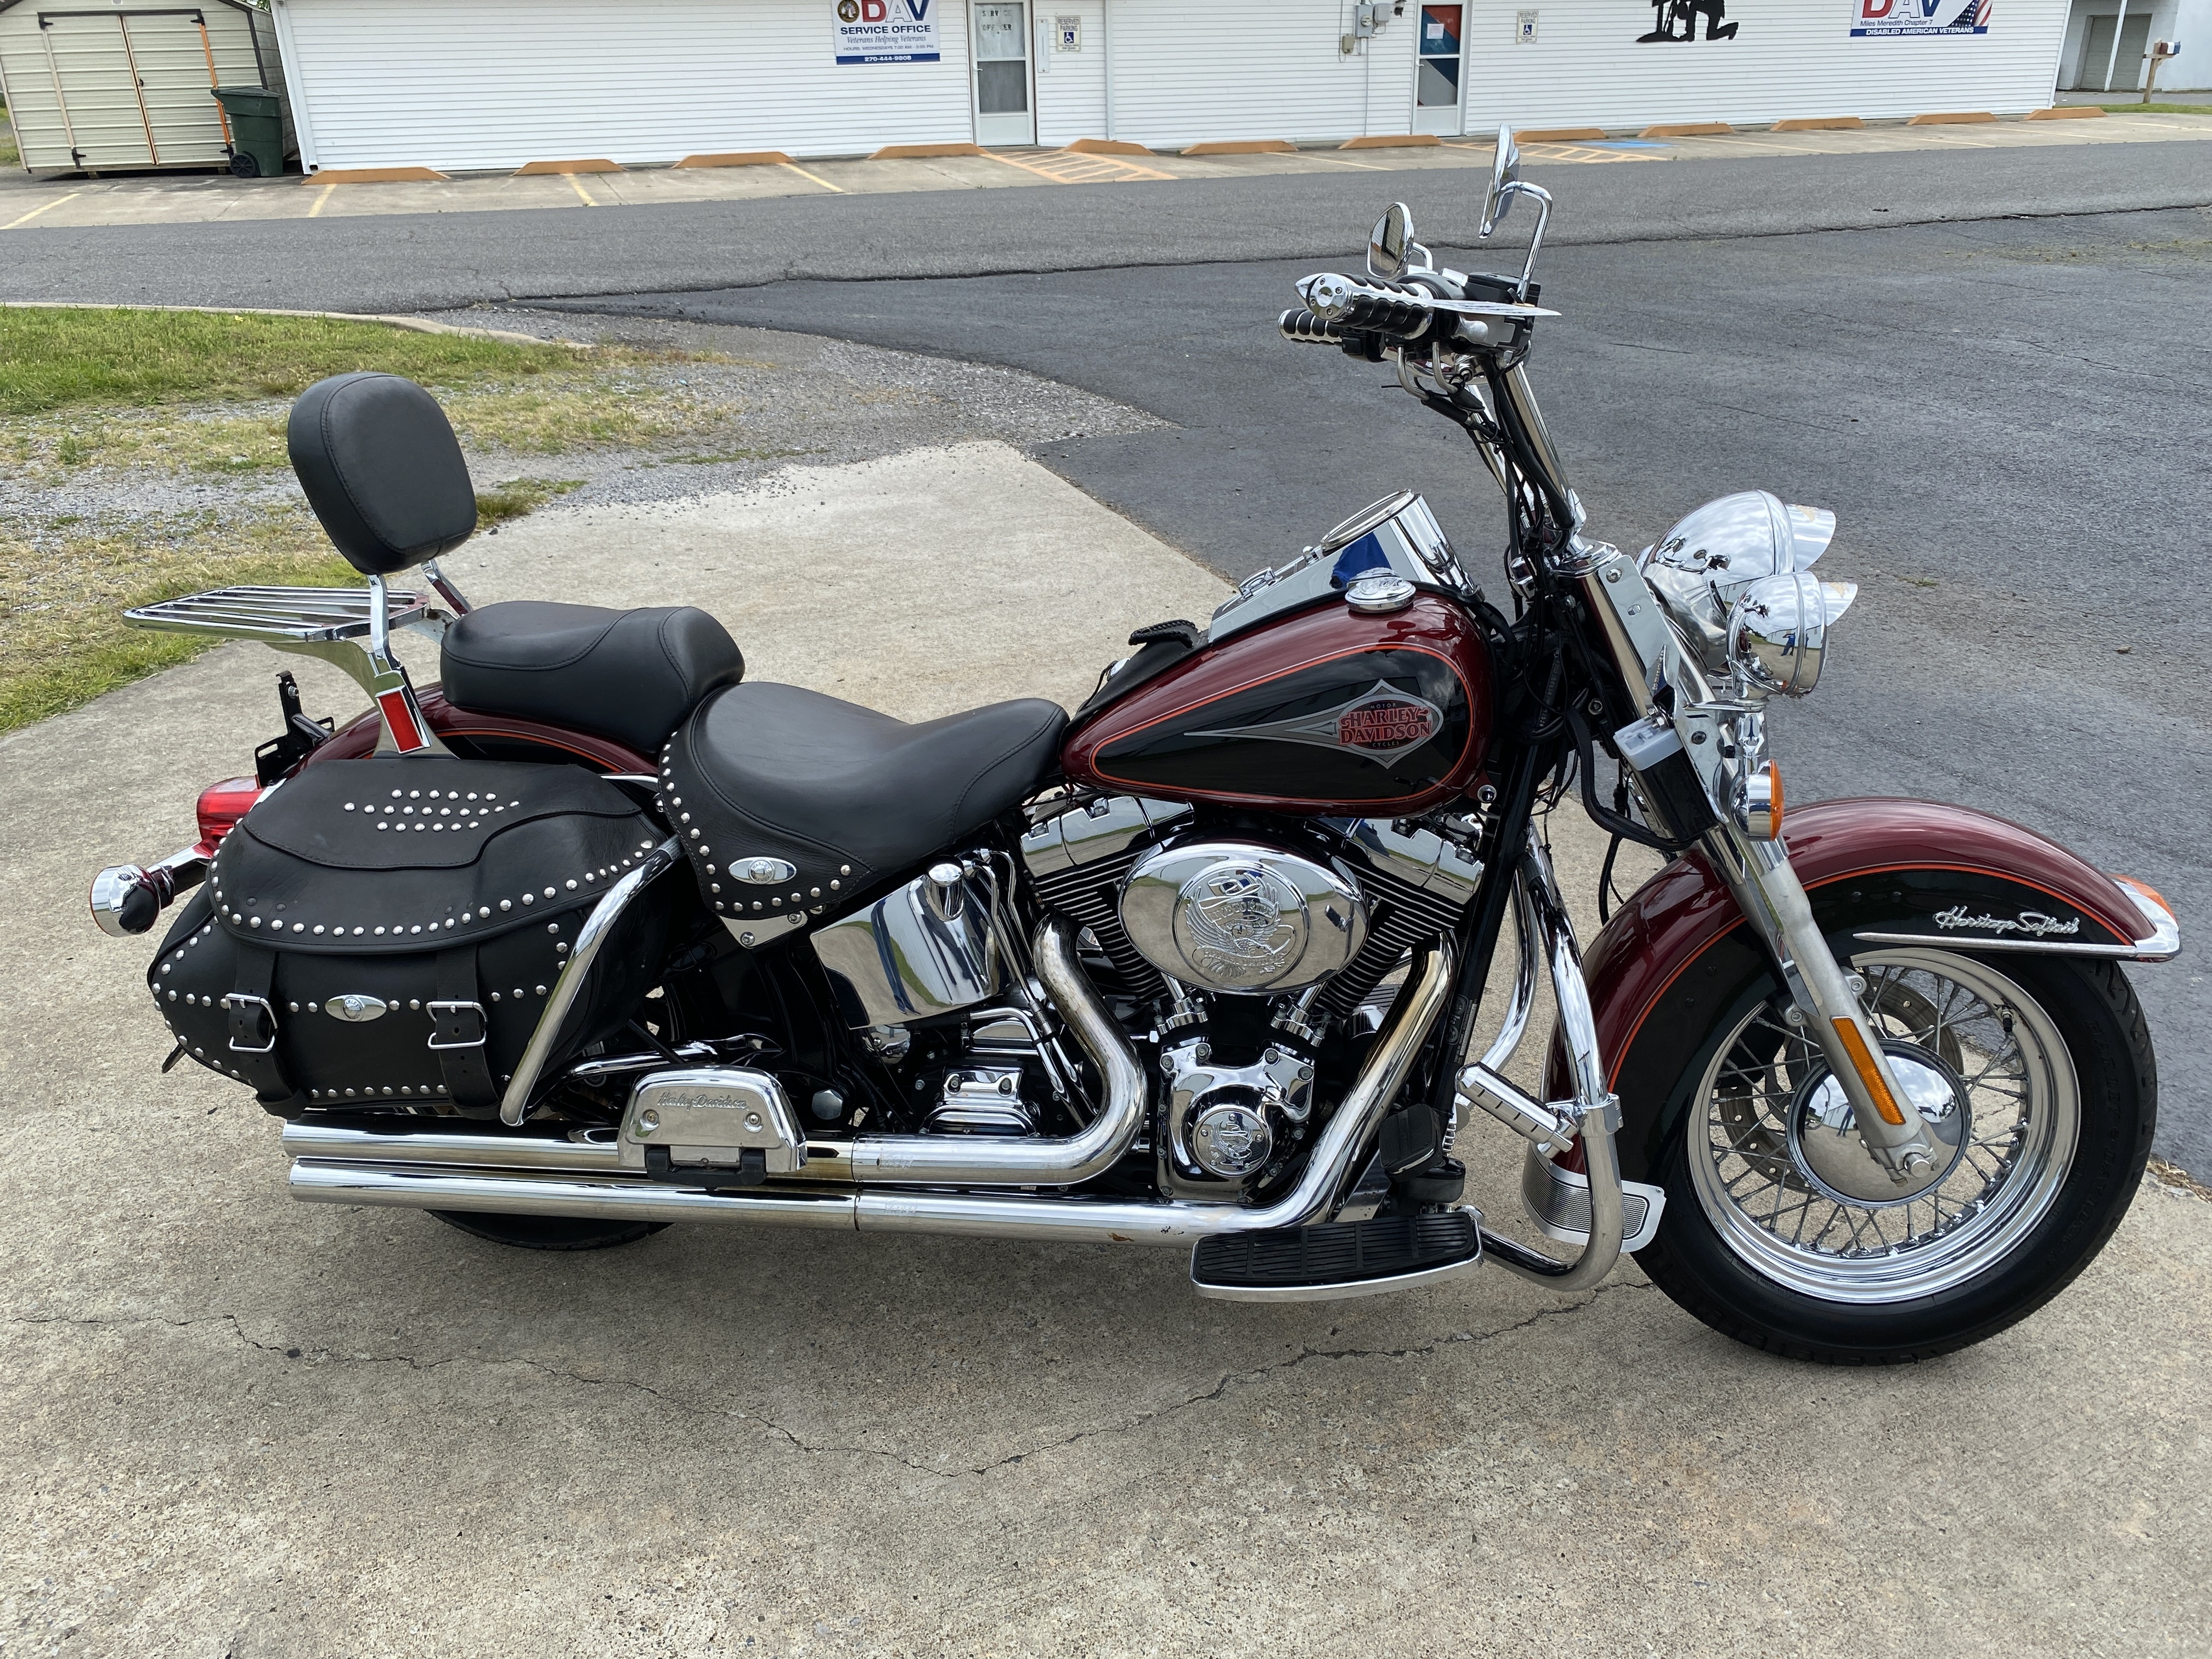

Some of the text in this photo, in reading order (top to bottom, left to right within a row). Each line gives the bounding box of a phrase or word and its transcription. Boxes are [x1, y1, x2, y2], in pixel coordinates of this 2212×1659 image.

[861, 0, 930, 22] DAV
[1862, 0, 1940, 18] DAV
[840, 25, 931, 35] SERVICE OFFICE
[874, 35, 899, 44] Helping
[1339, 721, 1431, 744] DAVIDSON
[1934, 905, 2080, 936] Heritage Softail
